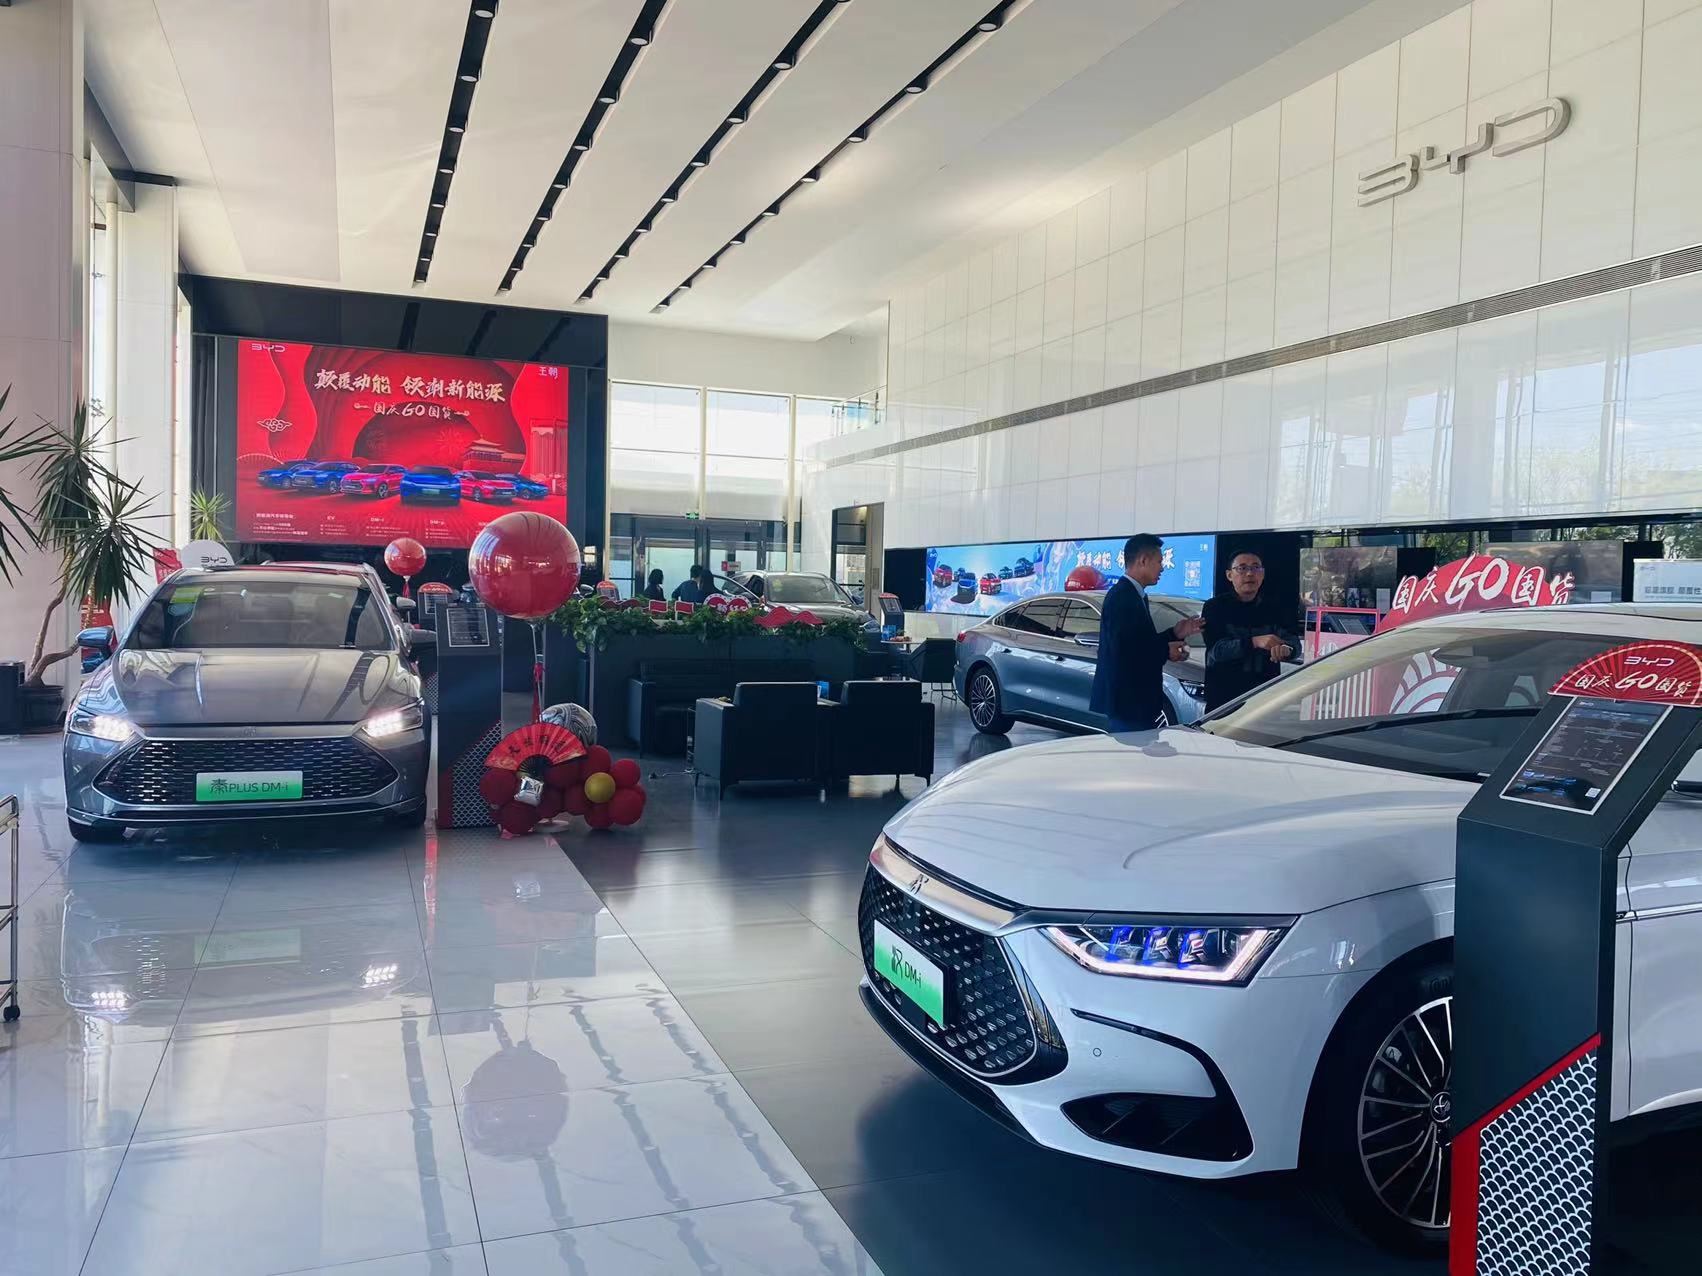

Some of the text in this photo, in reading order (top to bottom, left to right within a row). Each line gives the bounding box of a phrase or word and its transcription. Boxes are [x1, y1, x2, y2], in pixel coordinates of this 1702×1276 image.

[1357, 96, 1572, 208] BYD
[251, 342, 286, 353] BYD
[539, 366, 559, 379] 王朝
[314, 368, 391, 395] 颠覆动能
[200, 556, 228, 564] BYD
[1623, 655, 1675, 667] BYD
[262, 782, 289, 793] DM-i
